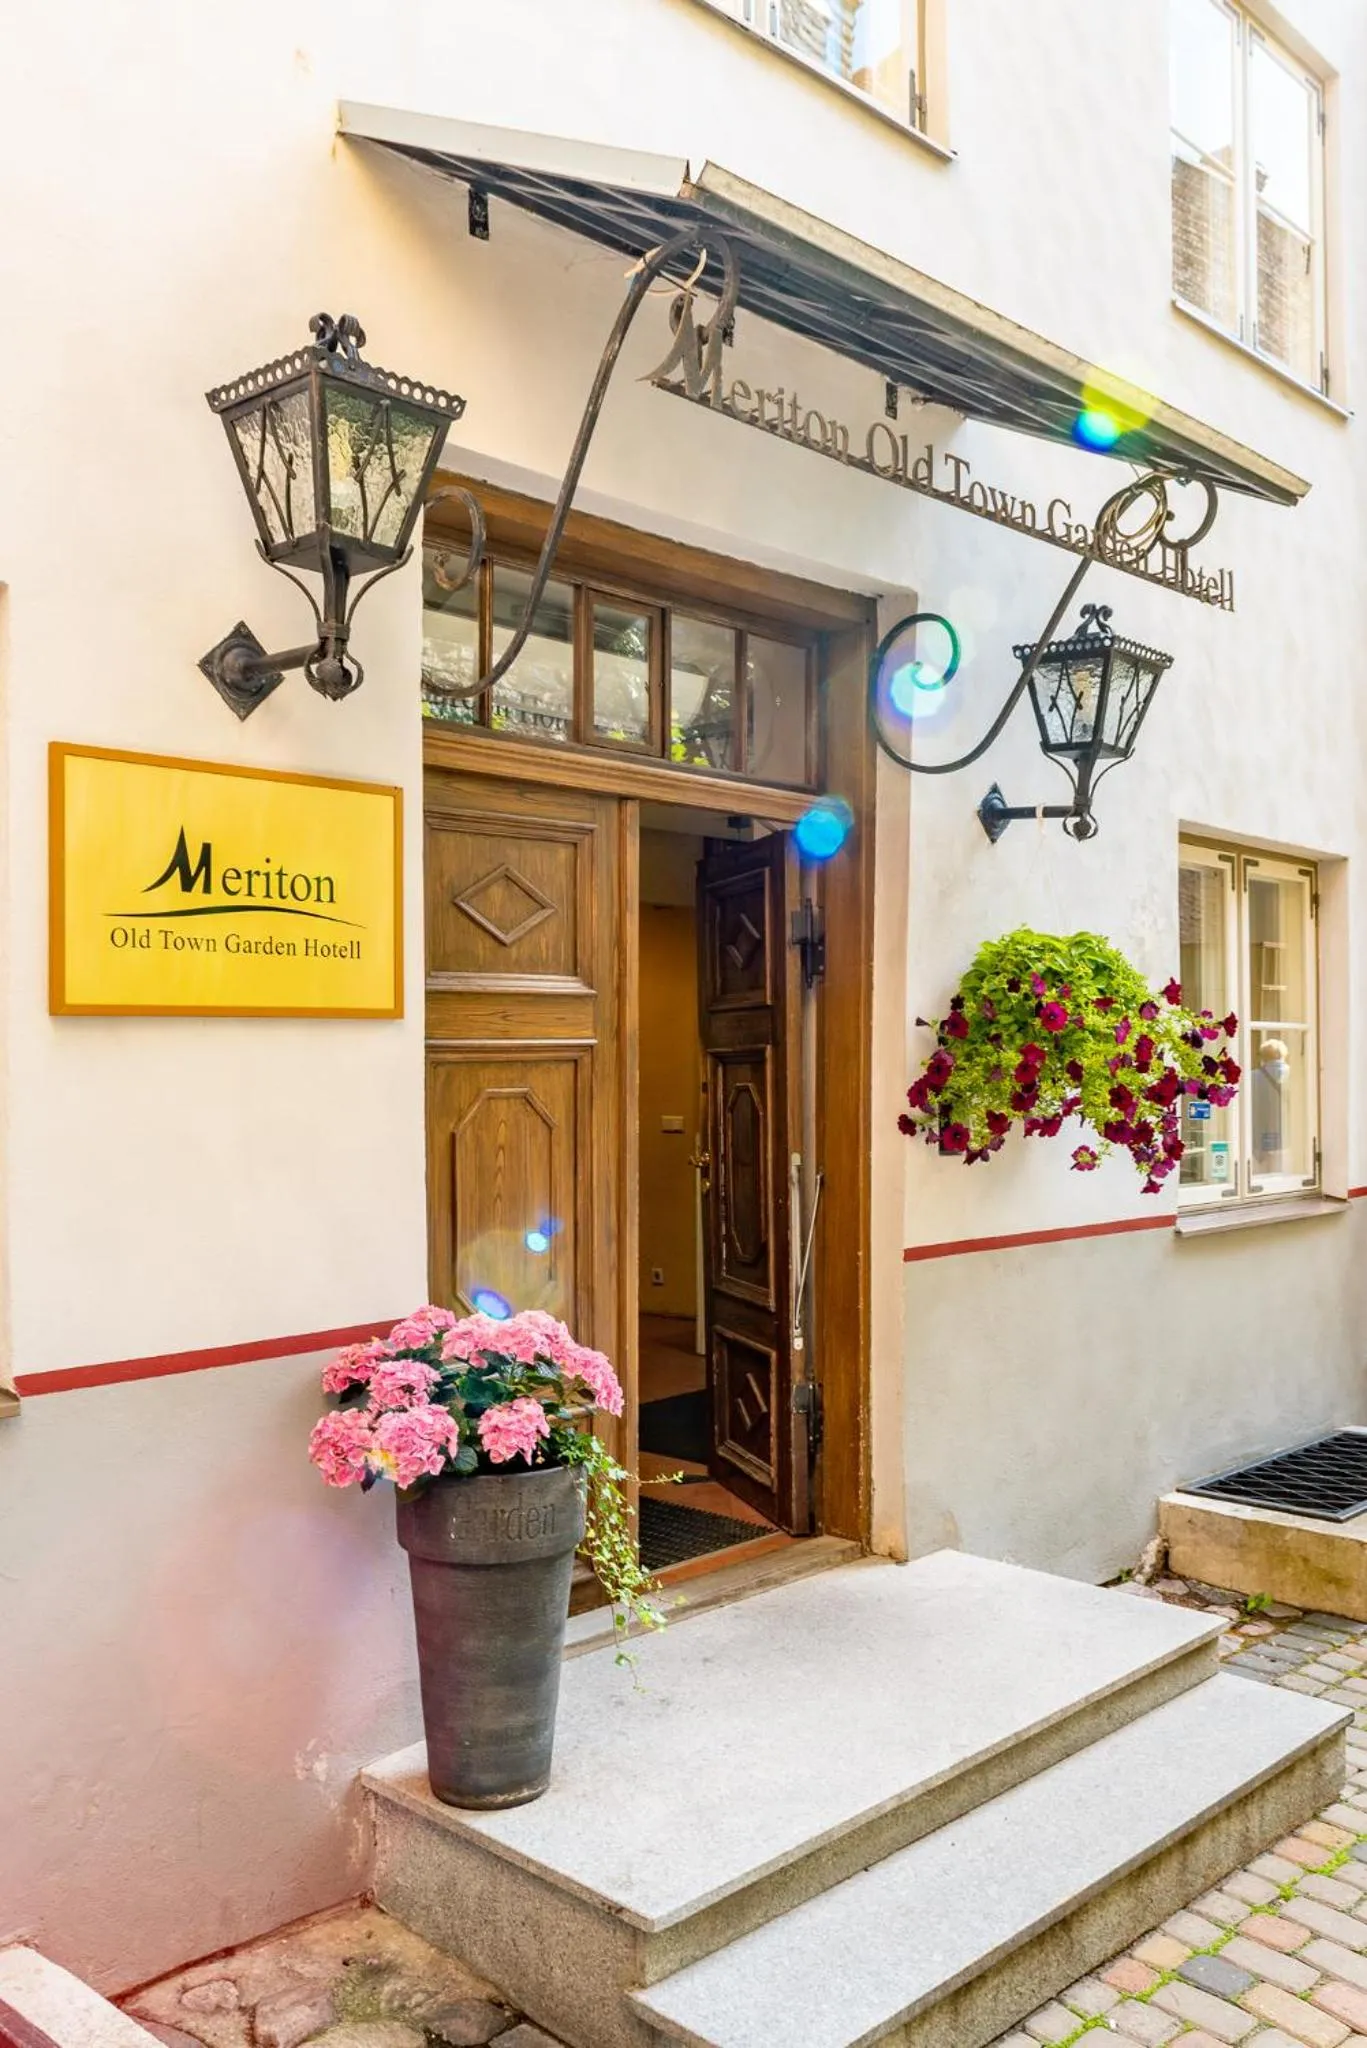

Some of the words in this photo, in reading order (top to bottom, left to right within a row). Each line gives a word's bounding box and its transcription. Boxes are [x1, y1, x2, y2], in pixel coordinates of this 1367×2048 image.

[635, 291, 849, 466] Meriton
[866, 422, 934, 496] Old
[944, 452, 1037, 531] Town
[140, 824, 337, 904] Meriton
[110, 926, 151, 950] Old
[158, 929, 217, 953] Town
[224, 933, 297, 957] Garden
[304, 938, 361, 960] Hotell
